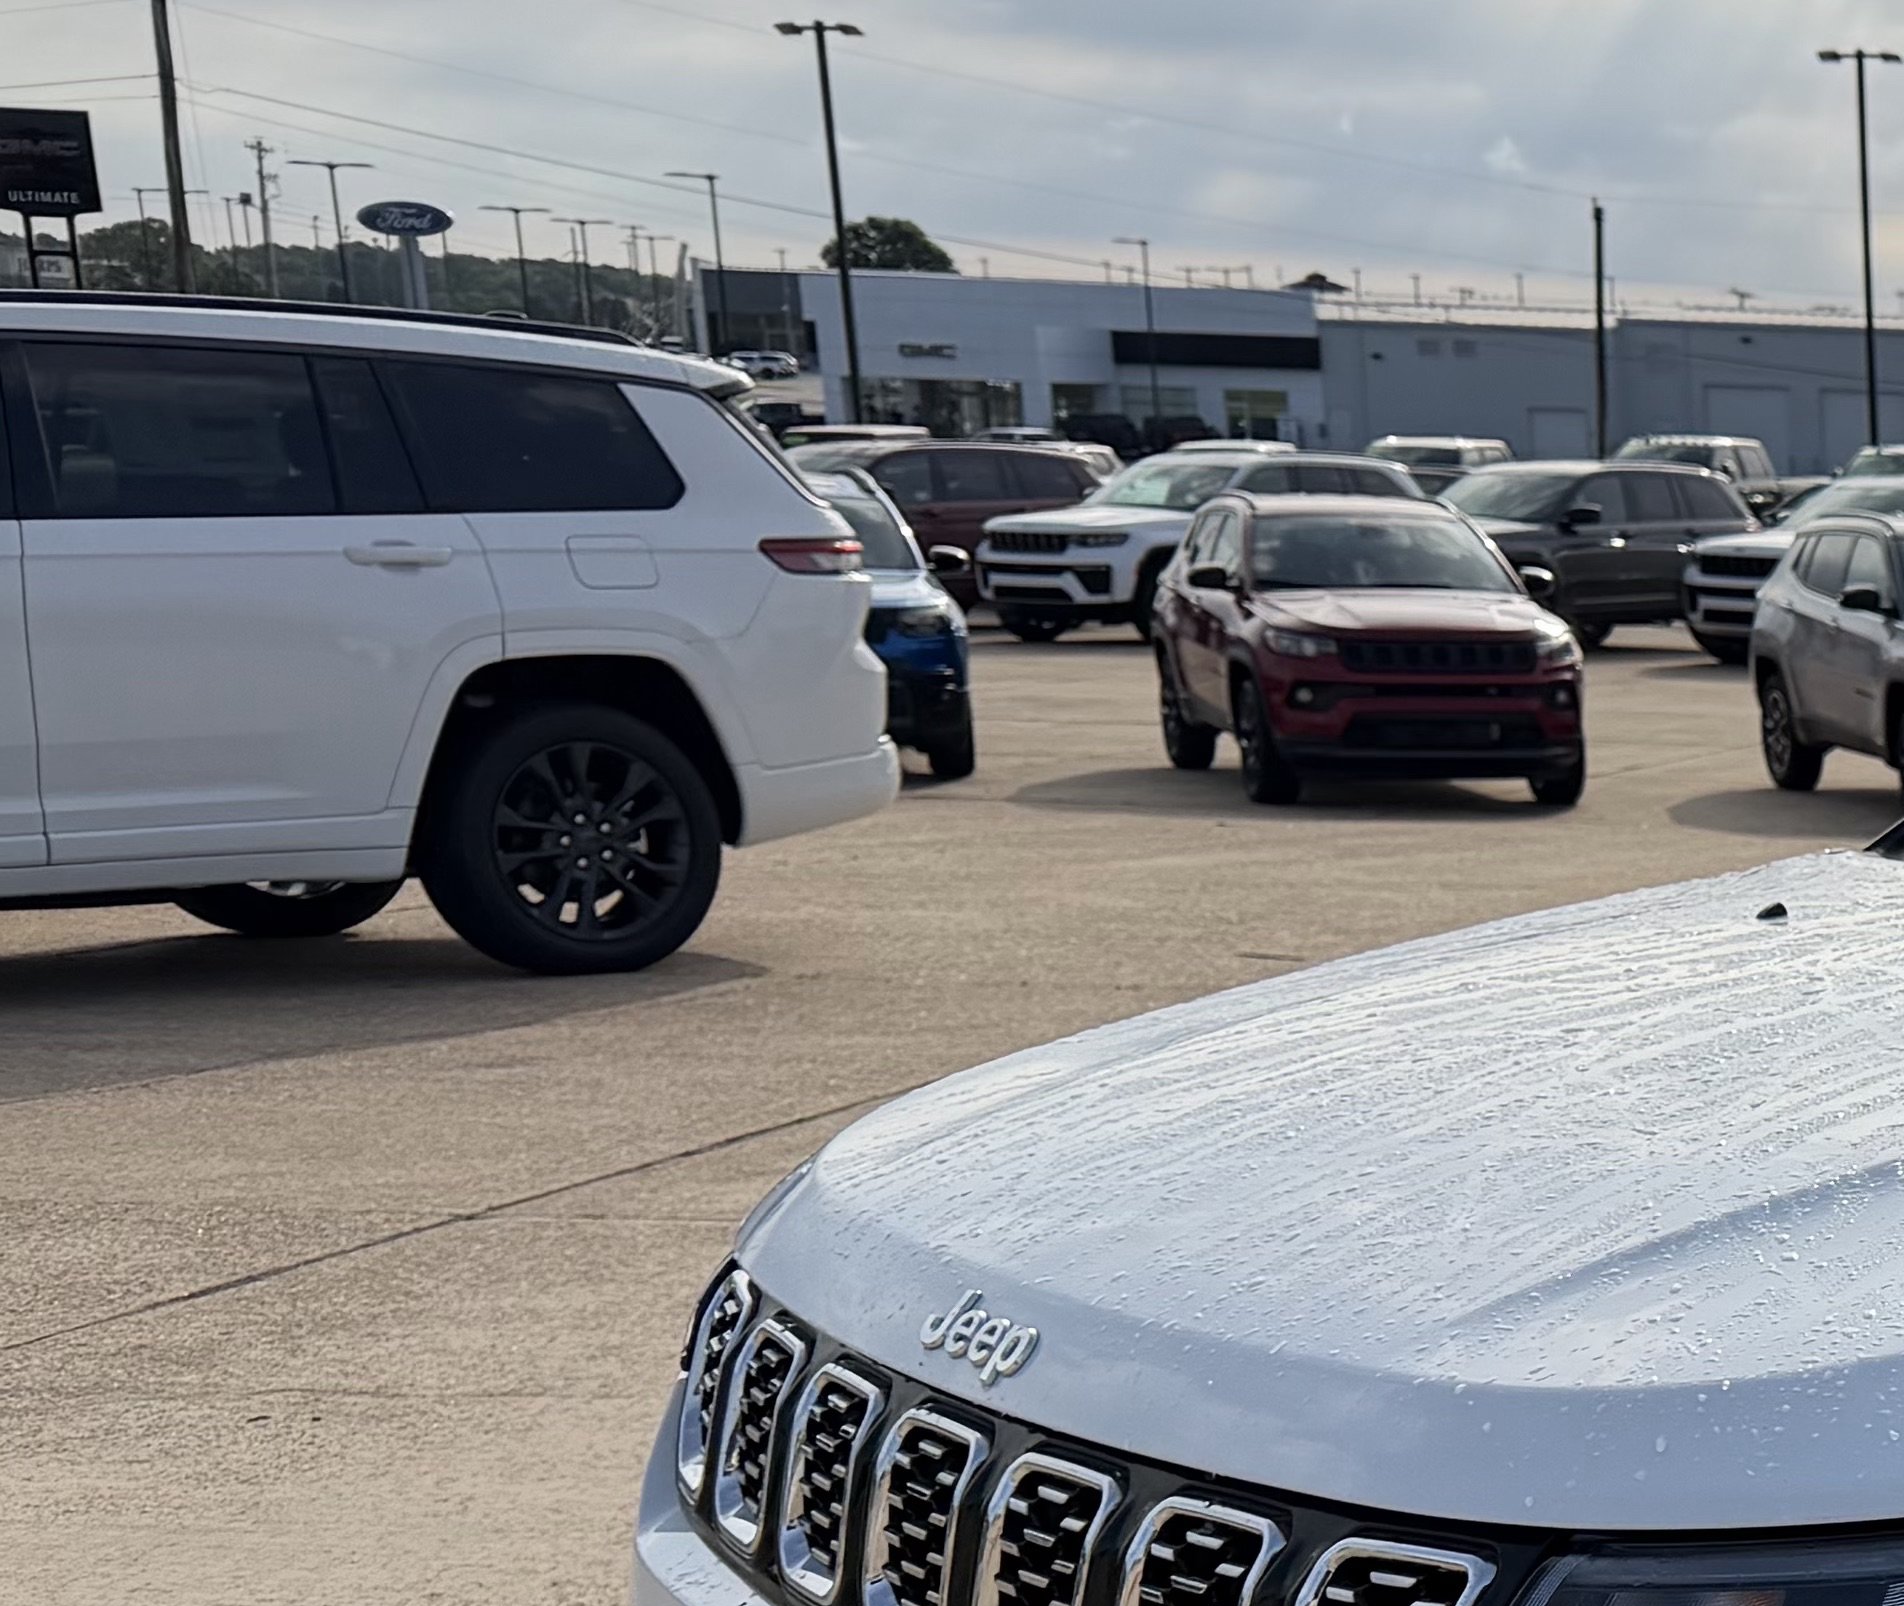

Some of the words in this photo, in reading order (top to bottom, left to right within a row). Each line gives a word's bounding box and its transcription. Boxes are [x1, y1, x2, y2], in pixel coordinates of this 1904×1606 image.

[8, 190, 80, 204] ULTIMATE
[376, 207, 433, 229] Ford
[898, 342, 958, 360] GMC
[920, 1289, 1039, 1386] Jeep
